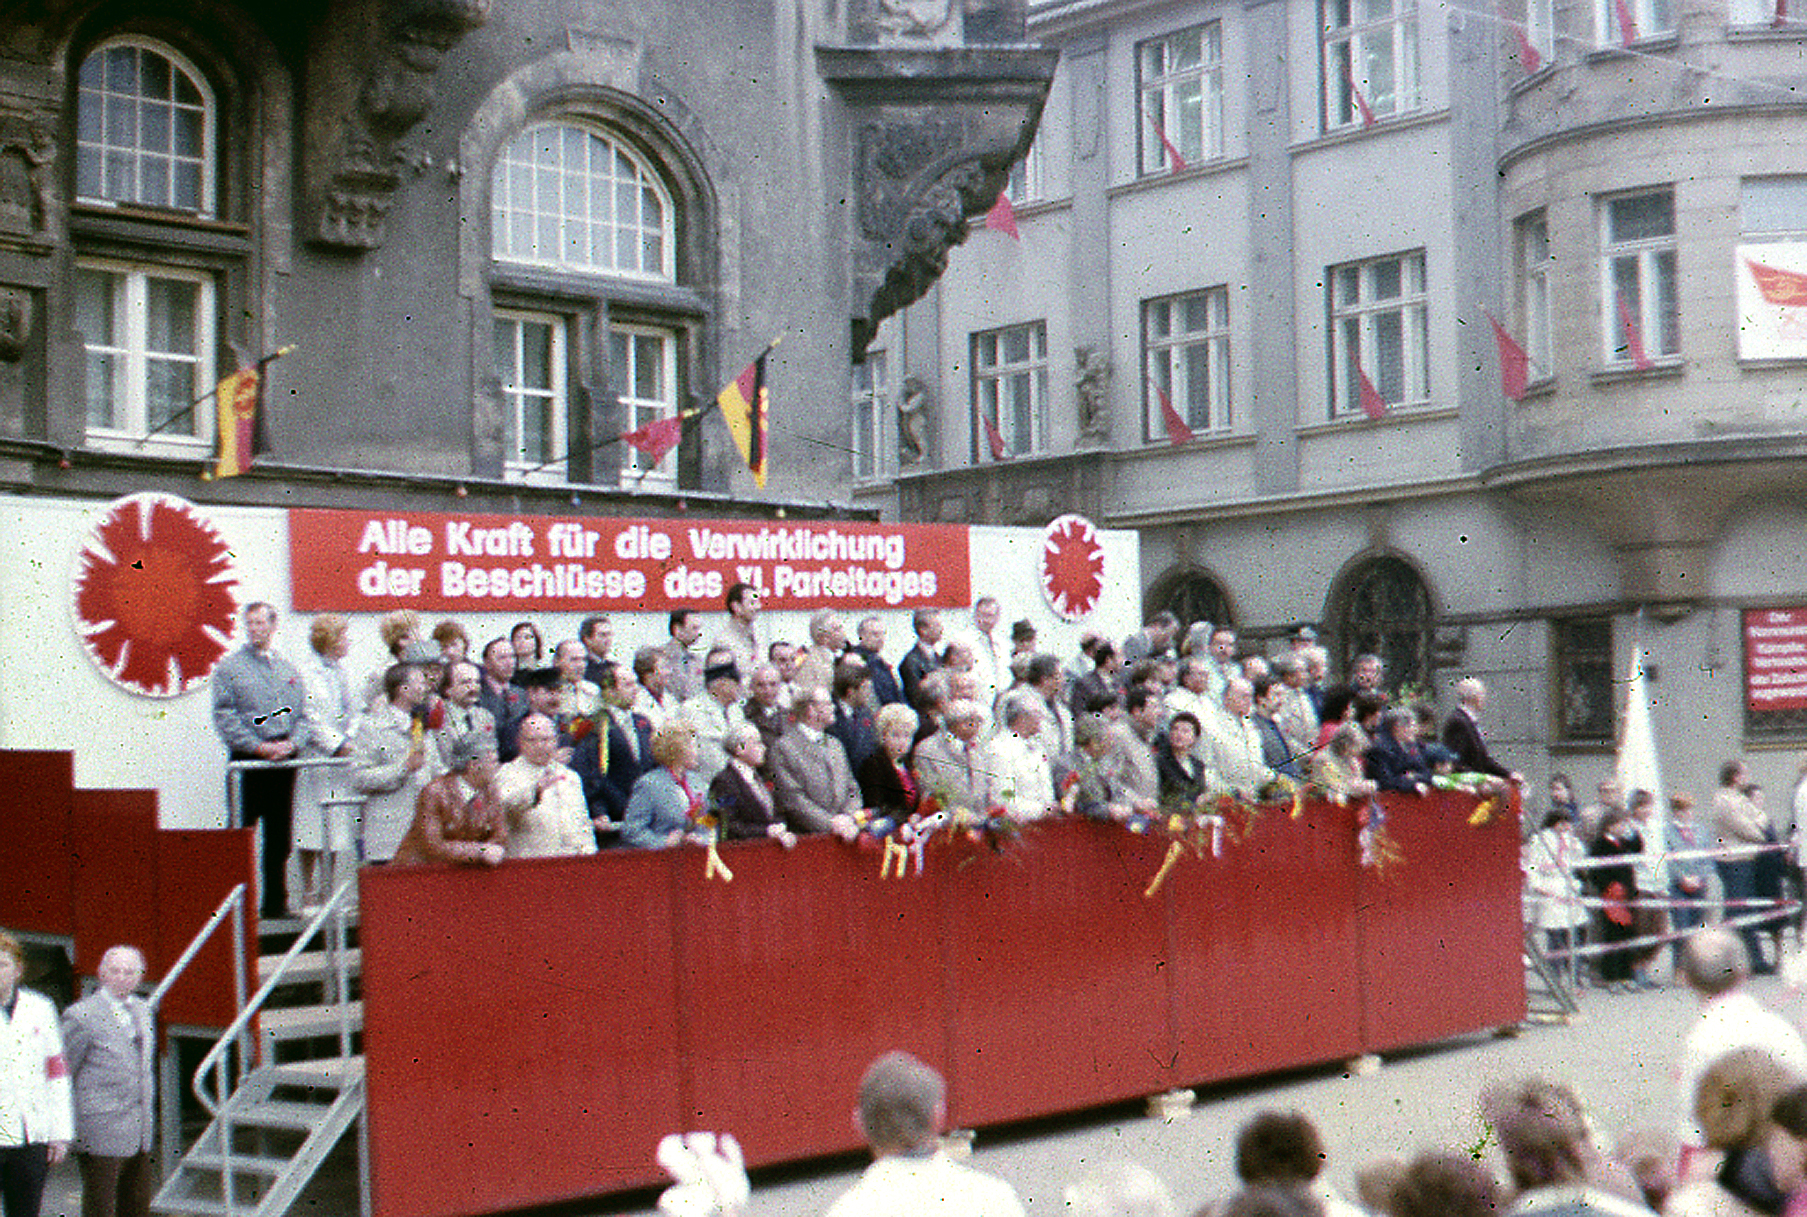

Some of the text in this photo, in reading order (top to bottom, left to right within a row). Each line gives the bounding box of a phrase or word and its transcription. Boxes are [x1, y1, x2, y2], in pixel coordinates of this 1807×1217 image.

[358, 519, 905, 568] Alle Kraft für die Verwirklichung
[358, 561, 425, 596] der
[441, 561, 646, 598] Beschlüsse
[664, 565, 723, 598] des
[774, 566, 937, 604] Parteitages
